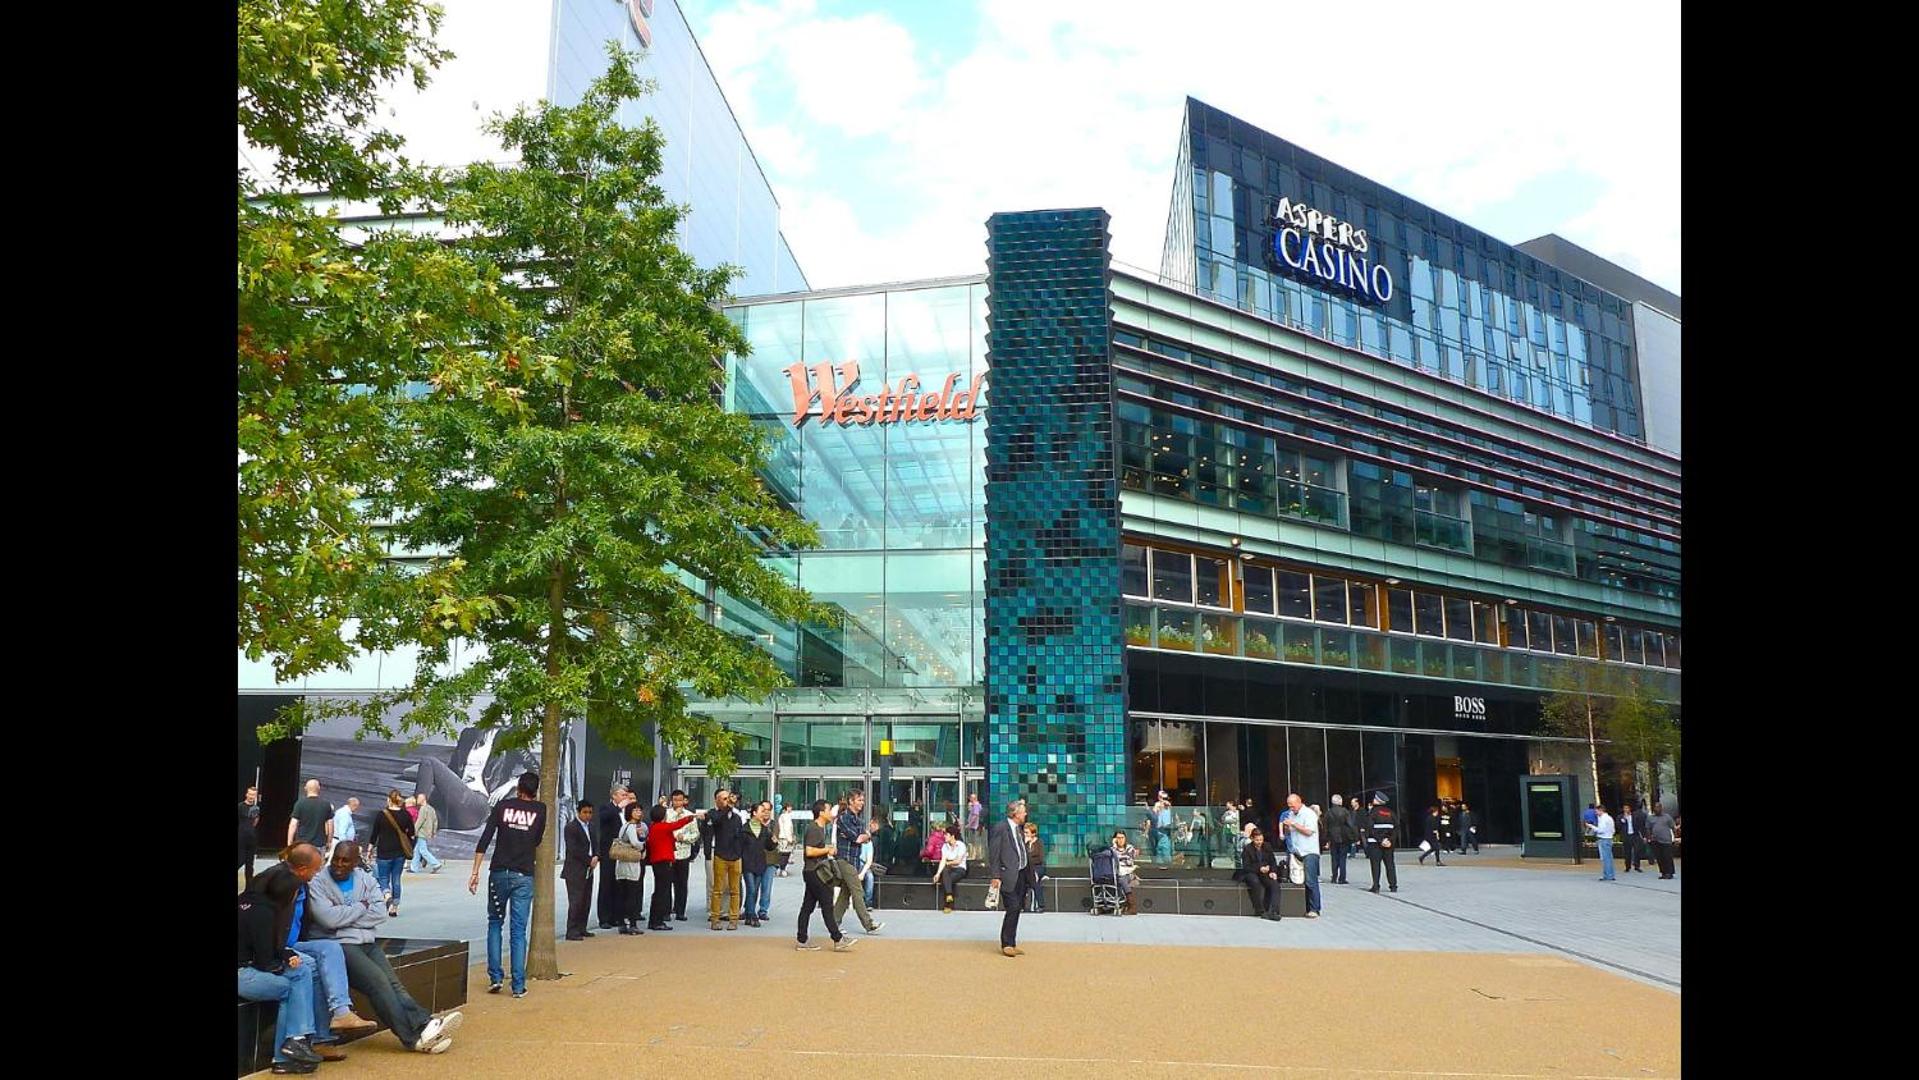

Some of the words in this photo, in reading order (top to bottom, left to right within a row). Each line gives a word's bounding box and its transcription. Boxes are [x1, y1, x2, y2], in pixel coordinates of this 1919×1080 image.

[1275, 196, 1369, 253] ASPERS
[1277, 227, 1393, 301] CASINO
[782, 359, 985, 428] Westfield
[1454, 695, 1486, 714] BOSS
